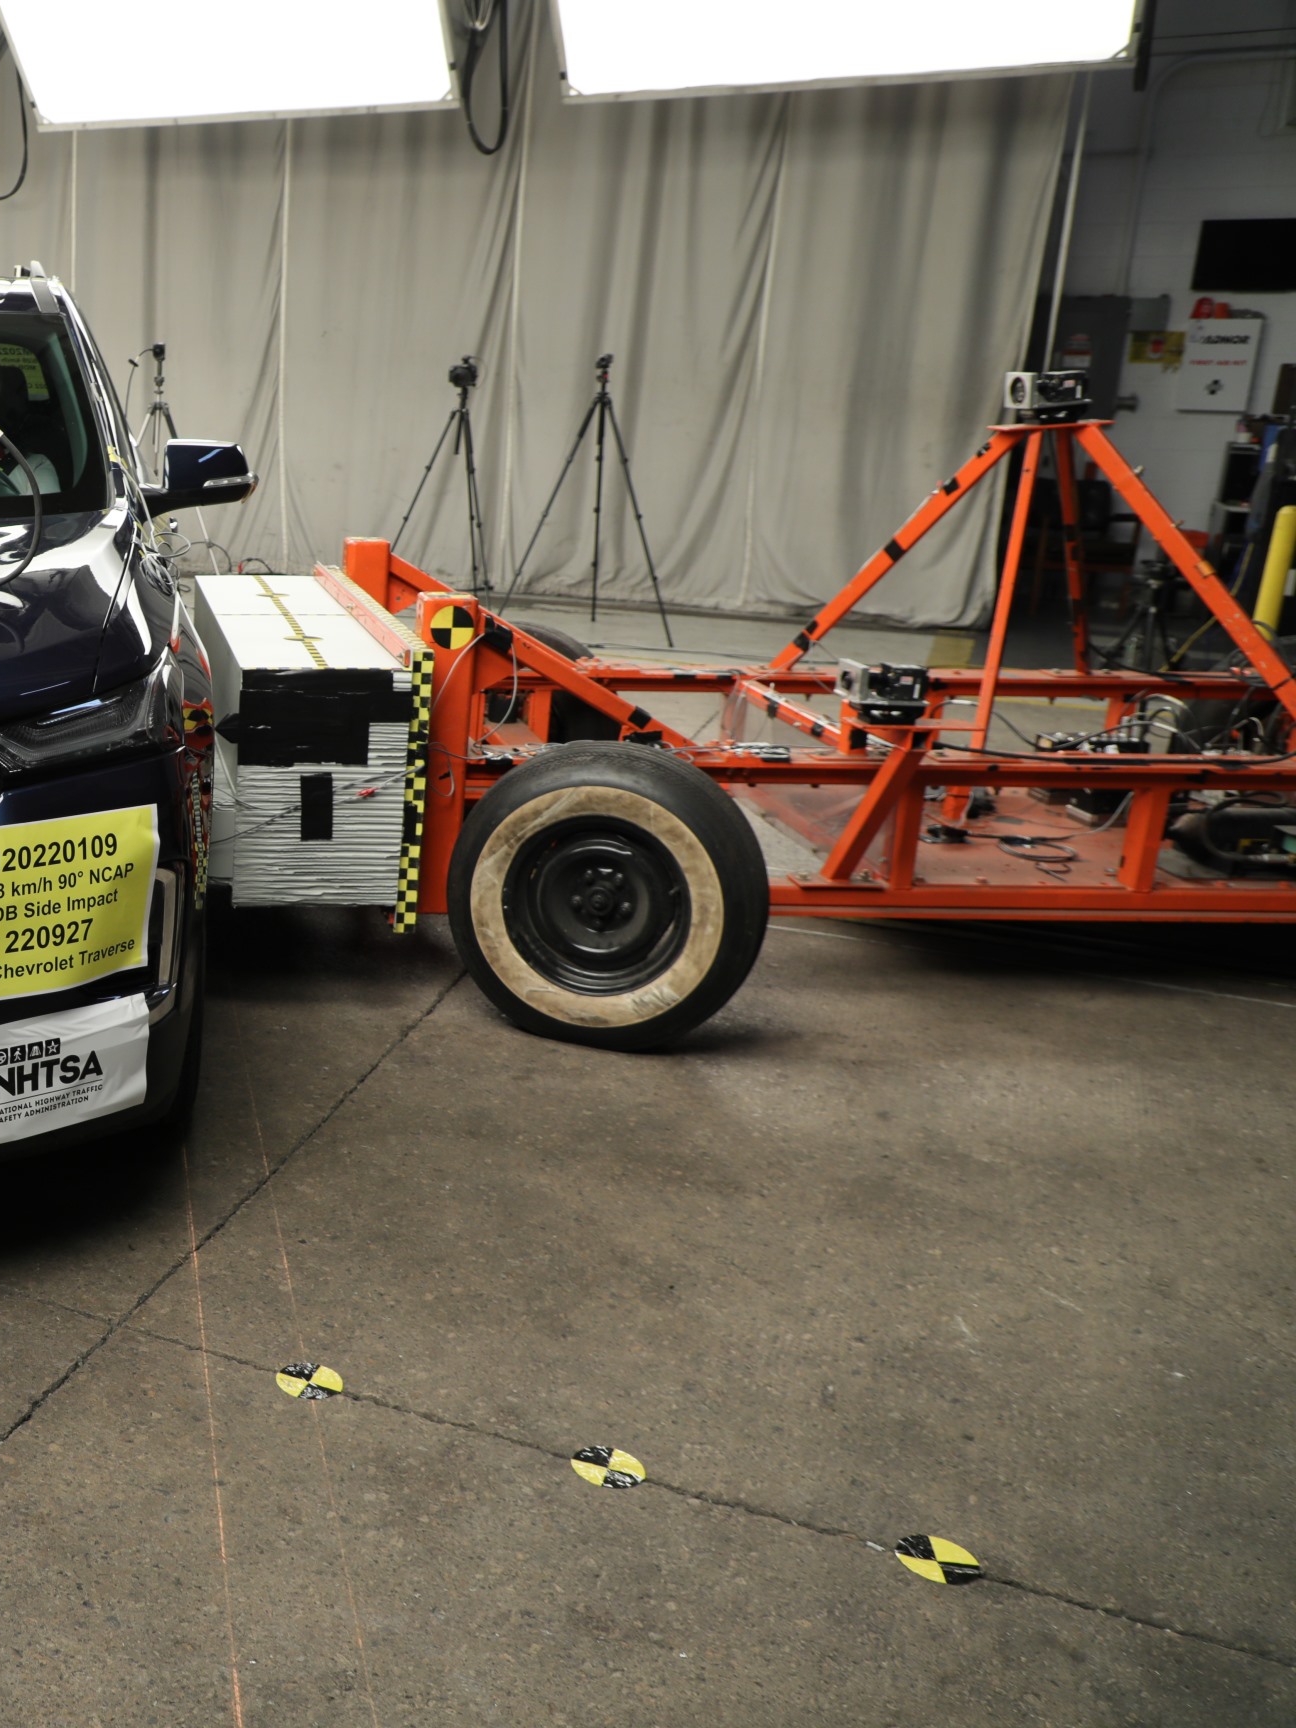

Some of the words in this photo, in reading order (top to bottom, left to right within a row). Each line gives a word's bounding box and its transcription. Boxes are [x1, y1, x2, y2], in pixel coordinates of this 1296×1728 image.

[11, 877, 53, 897] km/h
[58, 871, 84, 890] 90°
[89, 862, 135, 885] NCAP
[23, 900, 61, 918] Side
[66, 888, 119, 912] Impact
[4, 918, 94, 954] 220927
[78, 938, 135, 966] Traverse
[24, 1095, 89, 1118] ADMINISTRATION
[34, 1092, 71, 1107] HIGHWAY
[72, 1084, 104, 1096] TRAFFIC
